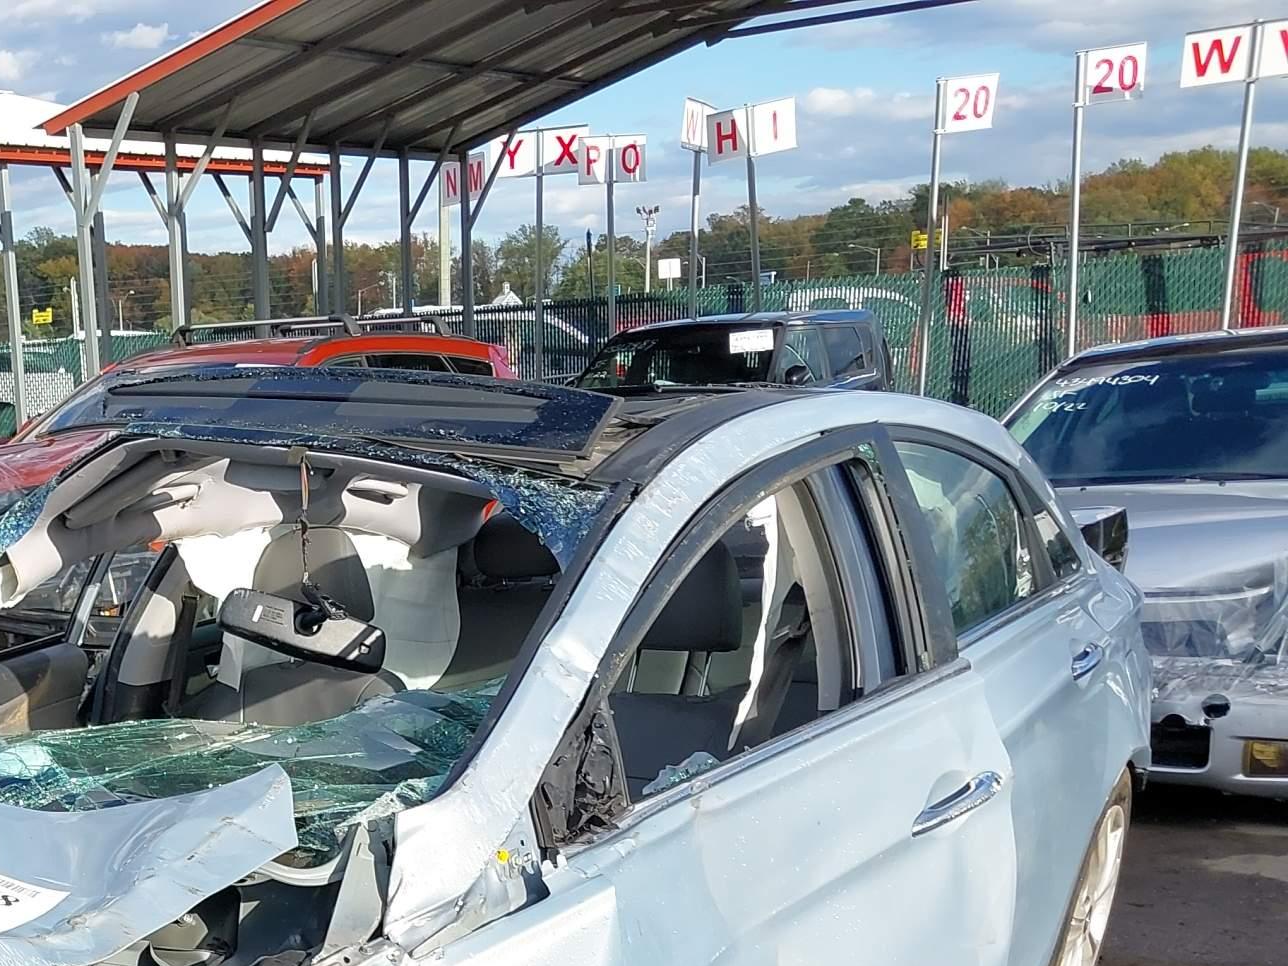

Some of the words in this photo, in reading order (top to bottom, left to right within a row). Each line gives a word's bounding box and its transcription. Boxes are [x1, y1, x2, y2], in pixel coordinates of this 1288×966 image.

[1191, 35, 1241, 76] W
[1092, 55, 1139, 95] 20
[951, 85, 991, 121] 20
[500, 139, 524, 170] Y
[554, 134, 579, 167] X
[715, 118, 738, 154] H
[446, 167, 458, 198] N
[468, 160, 483, 193] M
[585, 145, 601, 177] P
[1033, 401, 1088, 413] 10/22
